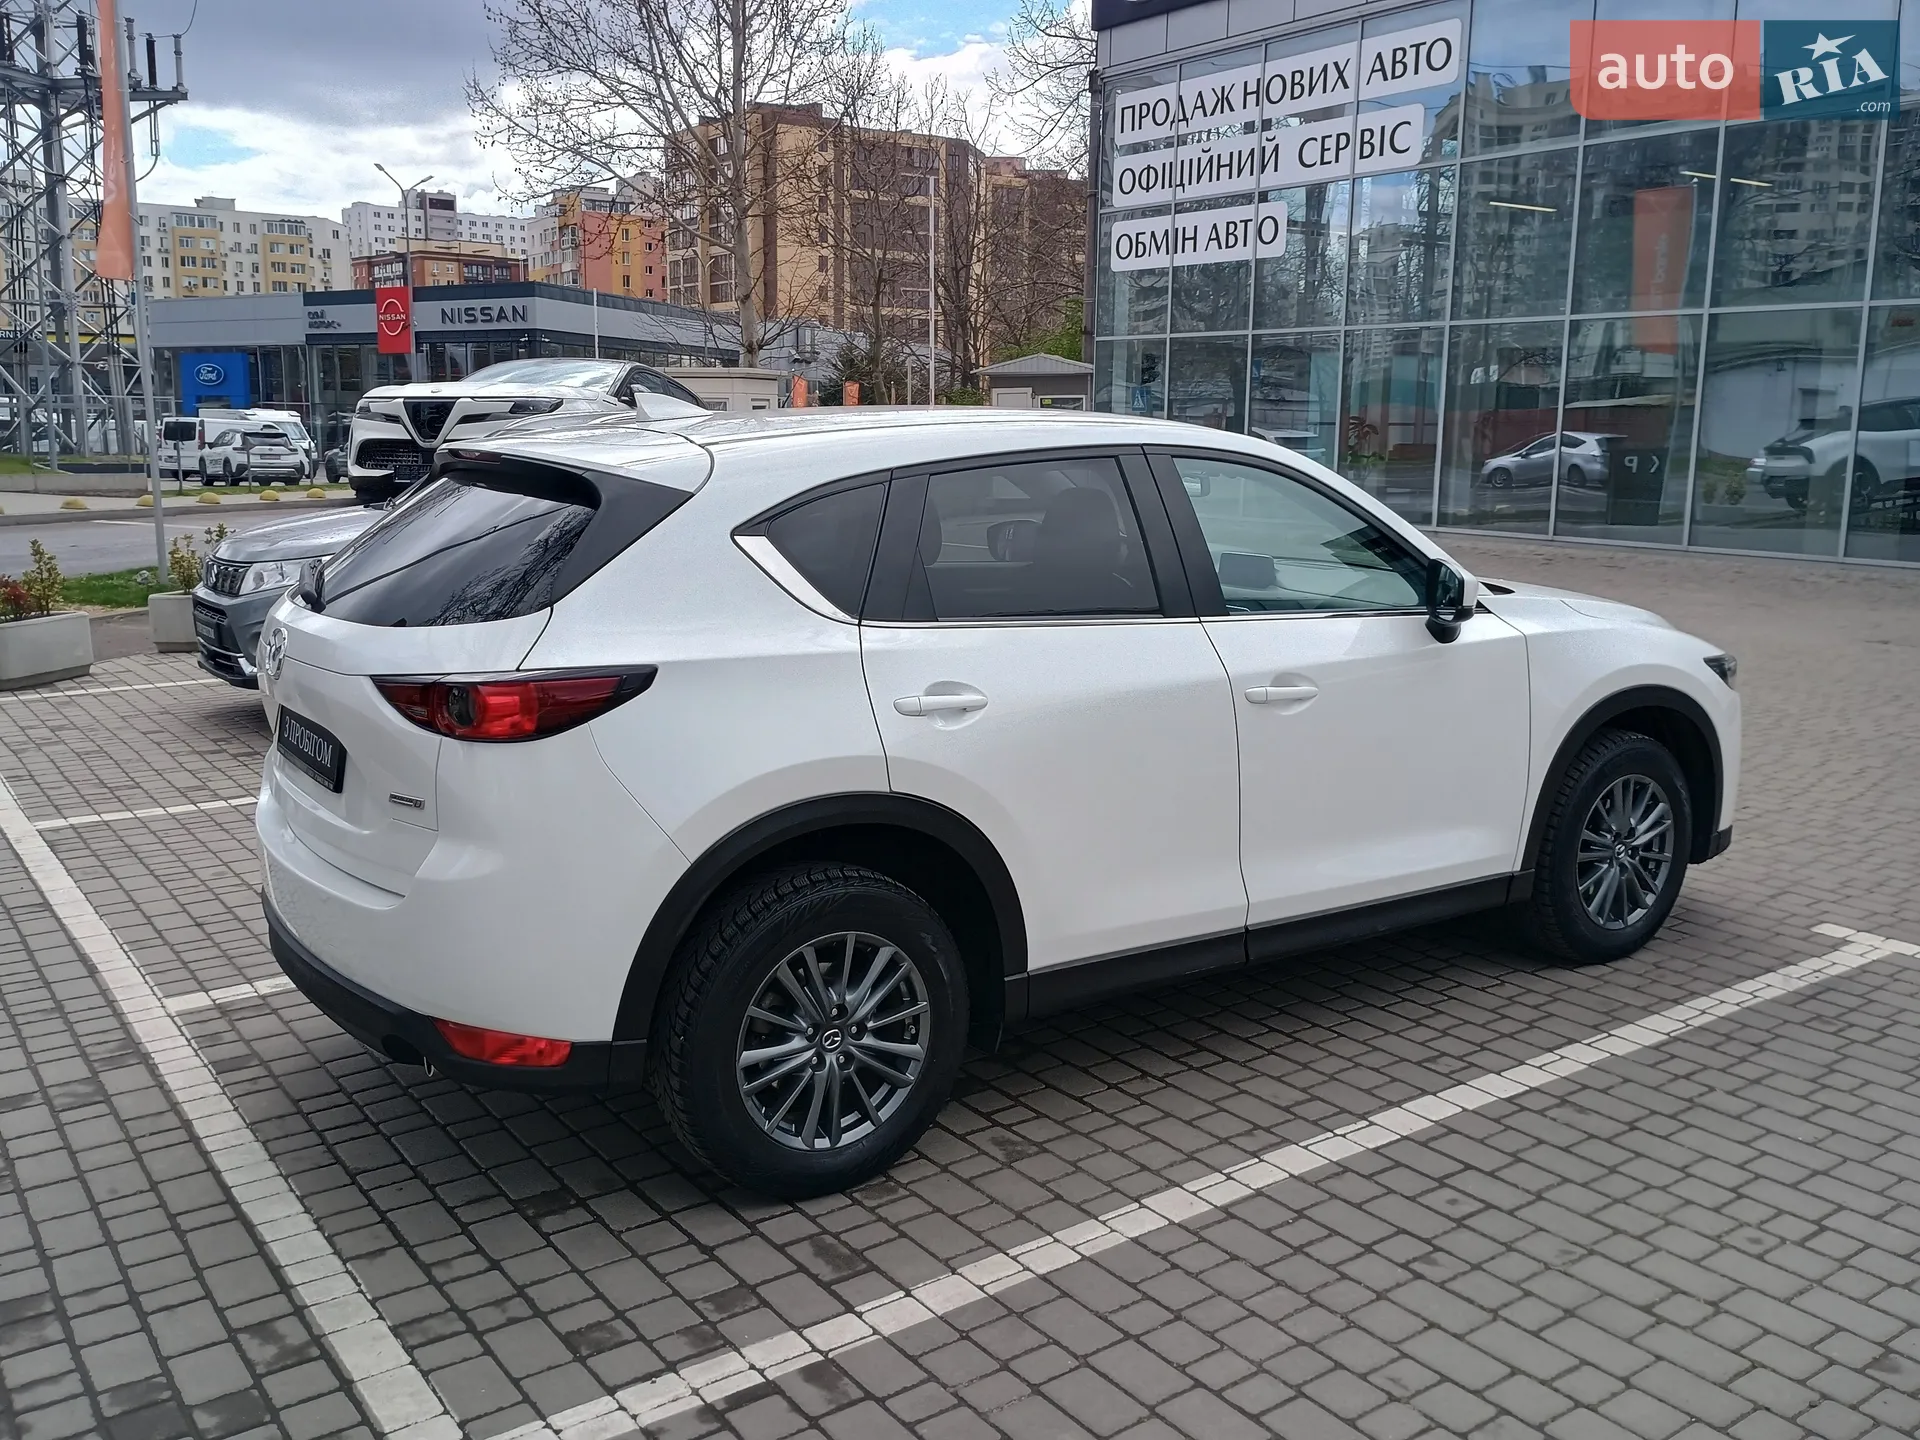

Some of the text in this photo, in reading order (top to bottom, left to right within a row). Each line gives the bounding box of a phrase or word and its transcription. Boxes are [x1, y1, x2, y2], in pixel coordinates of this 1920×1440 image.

[1120, 36, 1452, 133] ПРОДАЖ НОВИХ АВТО
[1118, 120, 1412, 195] ОФІЦІЙНИЙ СЕРВІС
[1115, 215, 1279, 260] ОБМІН АВТО
[378, 313, 406, 321] NISSAN
[441, 304, 528, 325] NISSAN
[199, 366, 218, 381] Ford
[289, 719, 333, 768] ПРОБІГОМ
